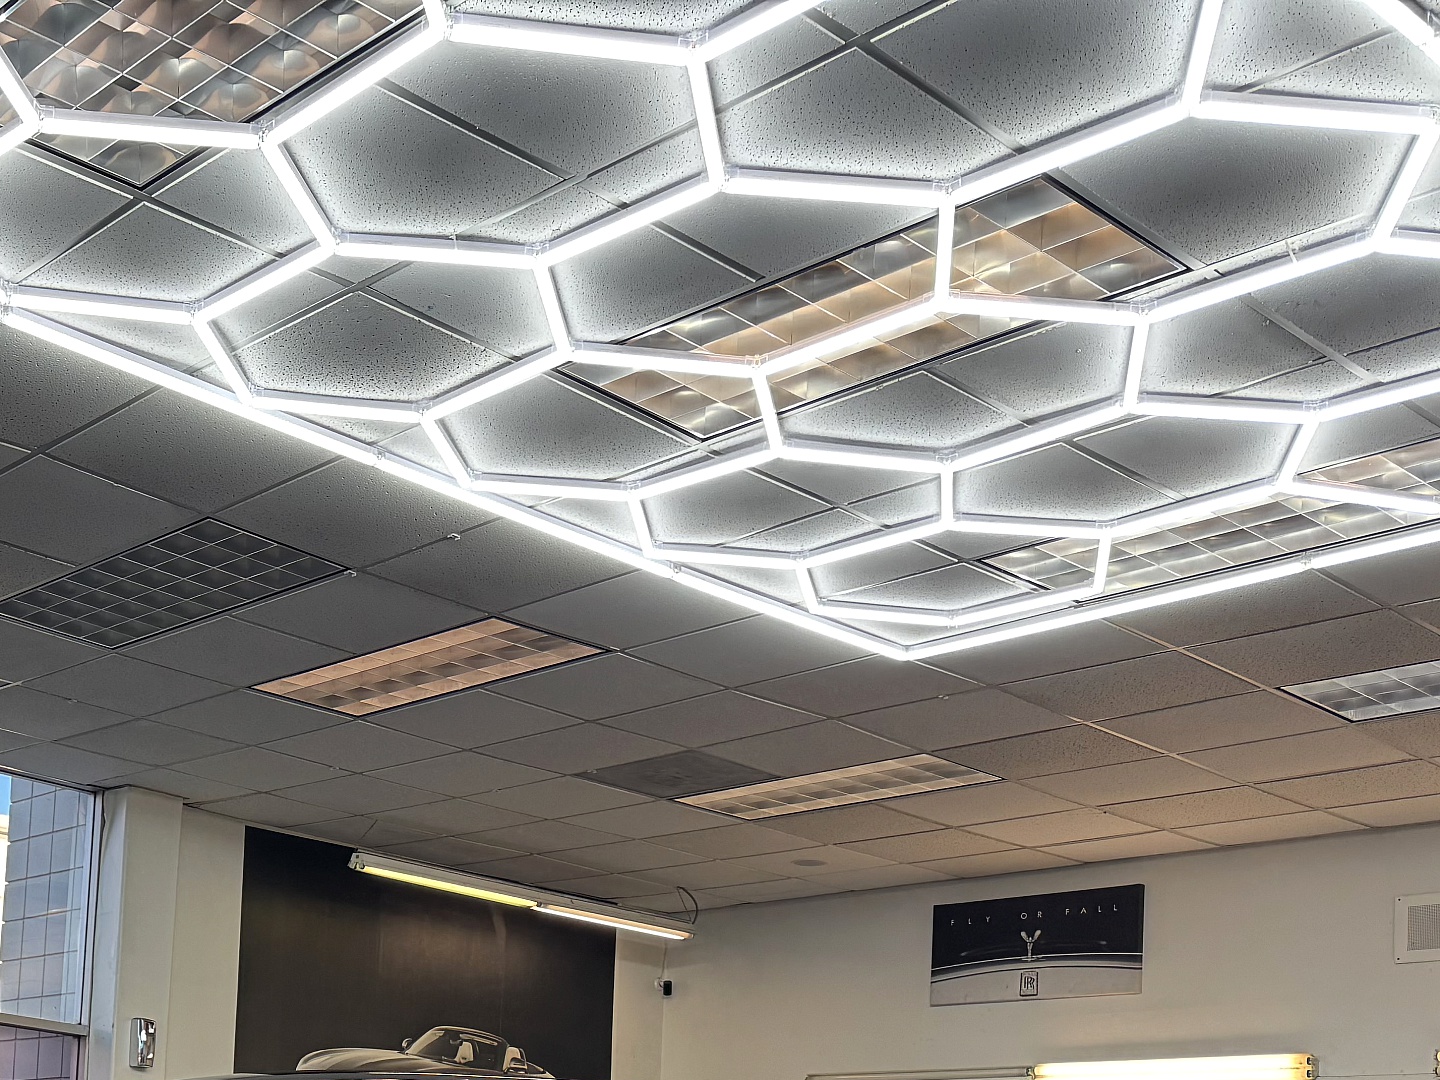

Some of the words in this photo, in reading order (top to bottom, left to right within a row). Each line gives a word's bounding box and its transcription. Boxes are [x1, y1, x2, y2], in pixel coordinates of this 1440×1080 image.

[950, 916, 990, 927] FLY
[1020, 911, 1043, 920] OR
[1065, 903, 1118, 916] FALL
